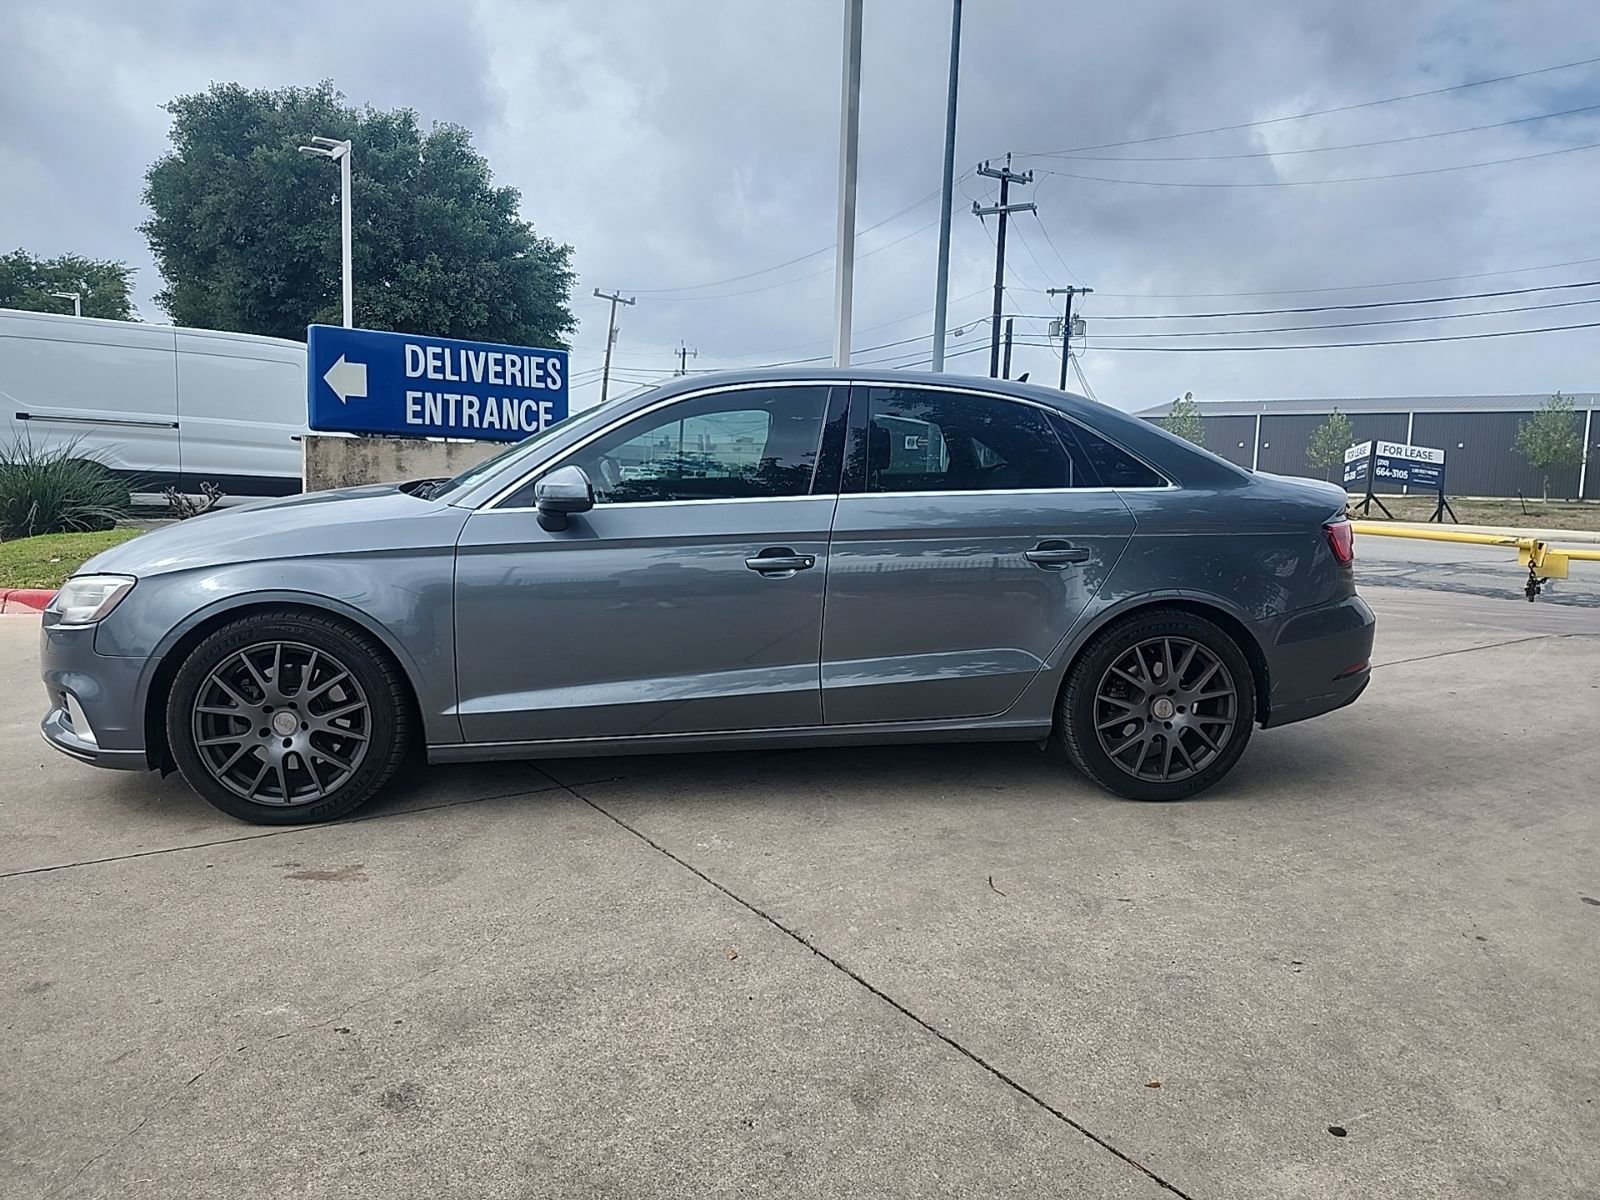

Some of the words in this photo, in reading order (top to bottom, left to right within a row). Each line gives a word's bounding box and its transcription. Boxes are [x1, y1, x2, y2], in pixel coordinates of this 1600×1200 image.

[405, 344, 562, 390] DELIVERIES
[405, 390, 553, 432] ENTRANCE
[1383, 445, 1402, 456] FOR
[1405, 448, 1433, 460] LEASE
[1375, 467, 1408, 479] 664-3105
